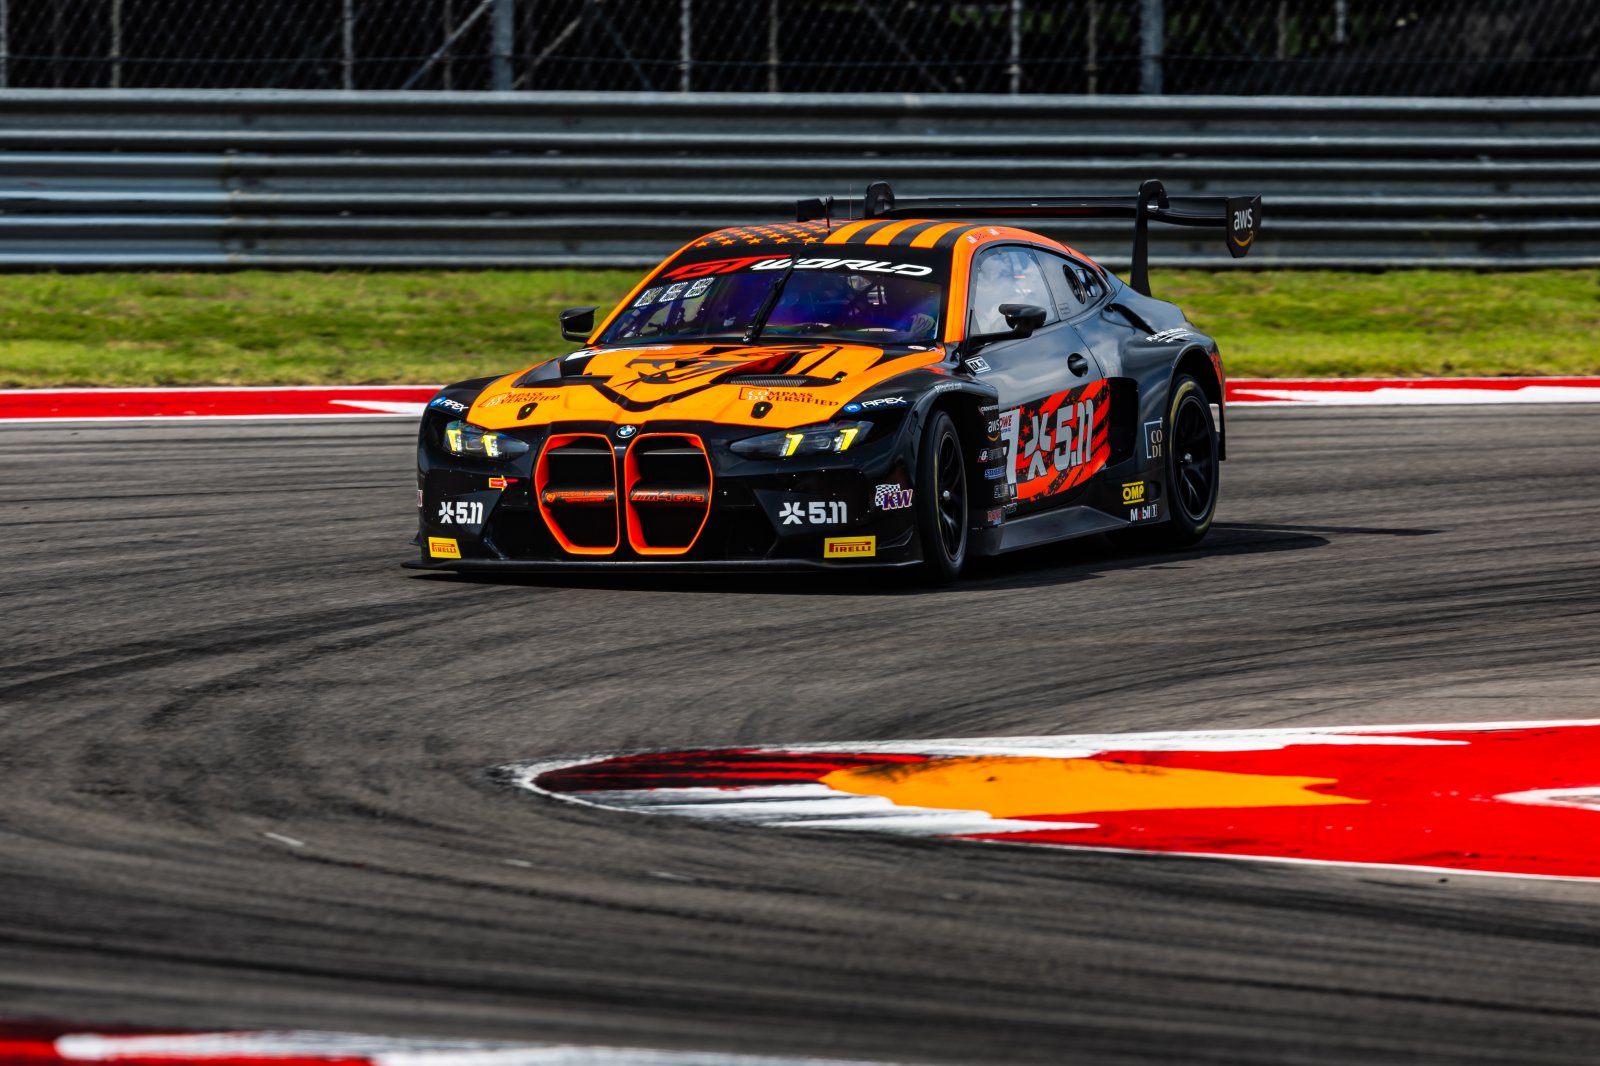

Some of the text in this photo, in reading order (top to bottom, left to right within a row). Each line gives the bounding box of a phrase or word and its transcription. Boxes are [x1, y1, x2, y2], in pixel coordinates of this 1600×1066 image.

[1233, 208, 1253, 231] aws
[661, 254, 933, 281] GT WORLD
[748, 390, 813, 398] COMPASS
[748, 395, 839, 407] DIVERSIFIED
[861, 396, 908, 408] APEX
[440, 399, 469, 412] APEX
[1054, 398, 1094, 472] 5.11
[1150, 430, 1163, 444] CO
[1151, 444, 1162, 459] DI
[882, 489, 913, 511] KW
[1122, 484, 1145, 501] OMP
[455, 501, 484, 525] 5.11
[808, 501, 848, 524] 5.11
[1130, 504, 1151, 522] Mobil
[431, 542, 457, 554] PIRELLI
[828, 541, 872, 553] PIRELLI
